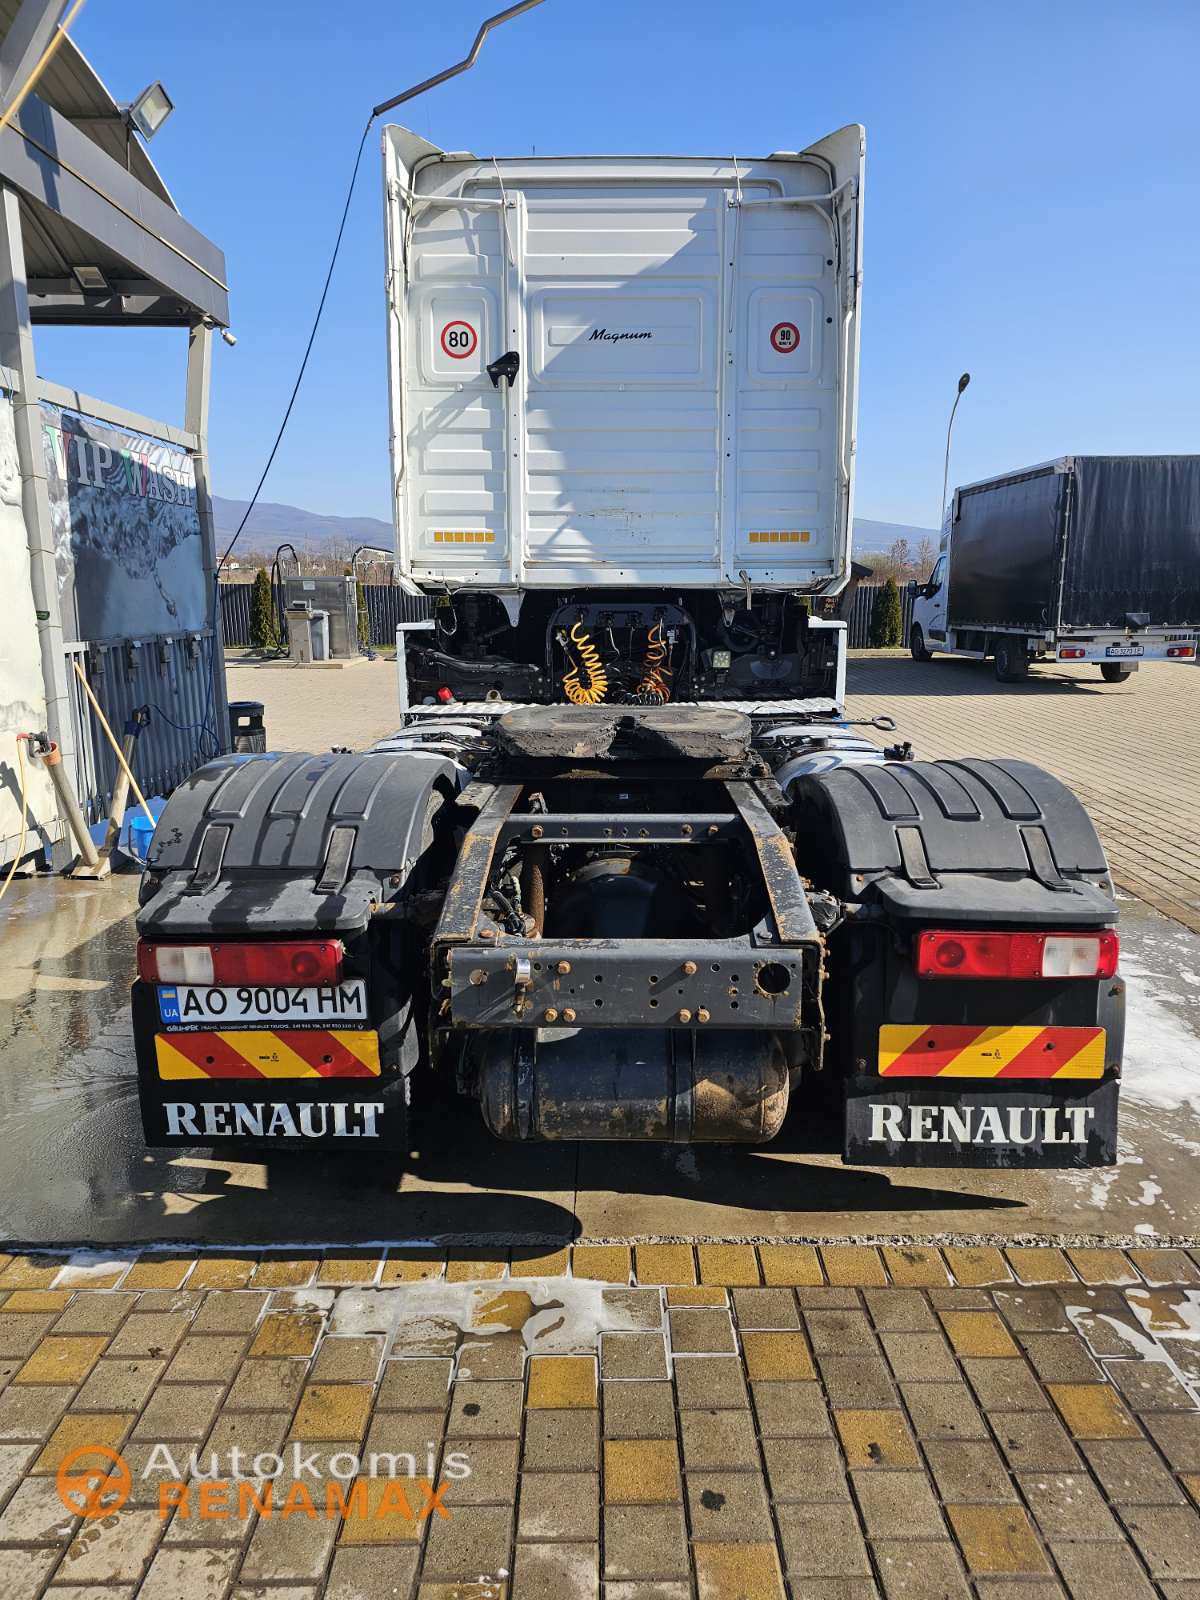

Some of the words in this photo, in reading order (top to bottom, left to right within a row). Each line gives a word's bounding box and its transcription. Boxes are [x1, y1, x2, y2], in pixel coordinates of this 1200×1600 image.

[448, 331, 469, 348] 80
[588, 328, 653, 343] Magnum
[780, 329, 791, 341] 90
[44, 424, 113, 489] VIP
[120, 448, 193, 508] WASH
[164, 1008, 179, 1018] UA
[182, 987, 228, 1017] AO
[236, 987, 309, 1015] 9004
[317, 985, 363, 1014] HM
[161, 1102, 385, 1138] RENAULT
[867, 1103, 1096, 1144] RENAULT
